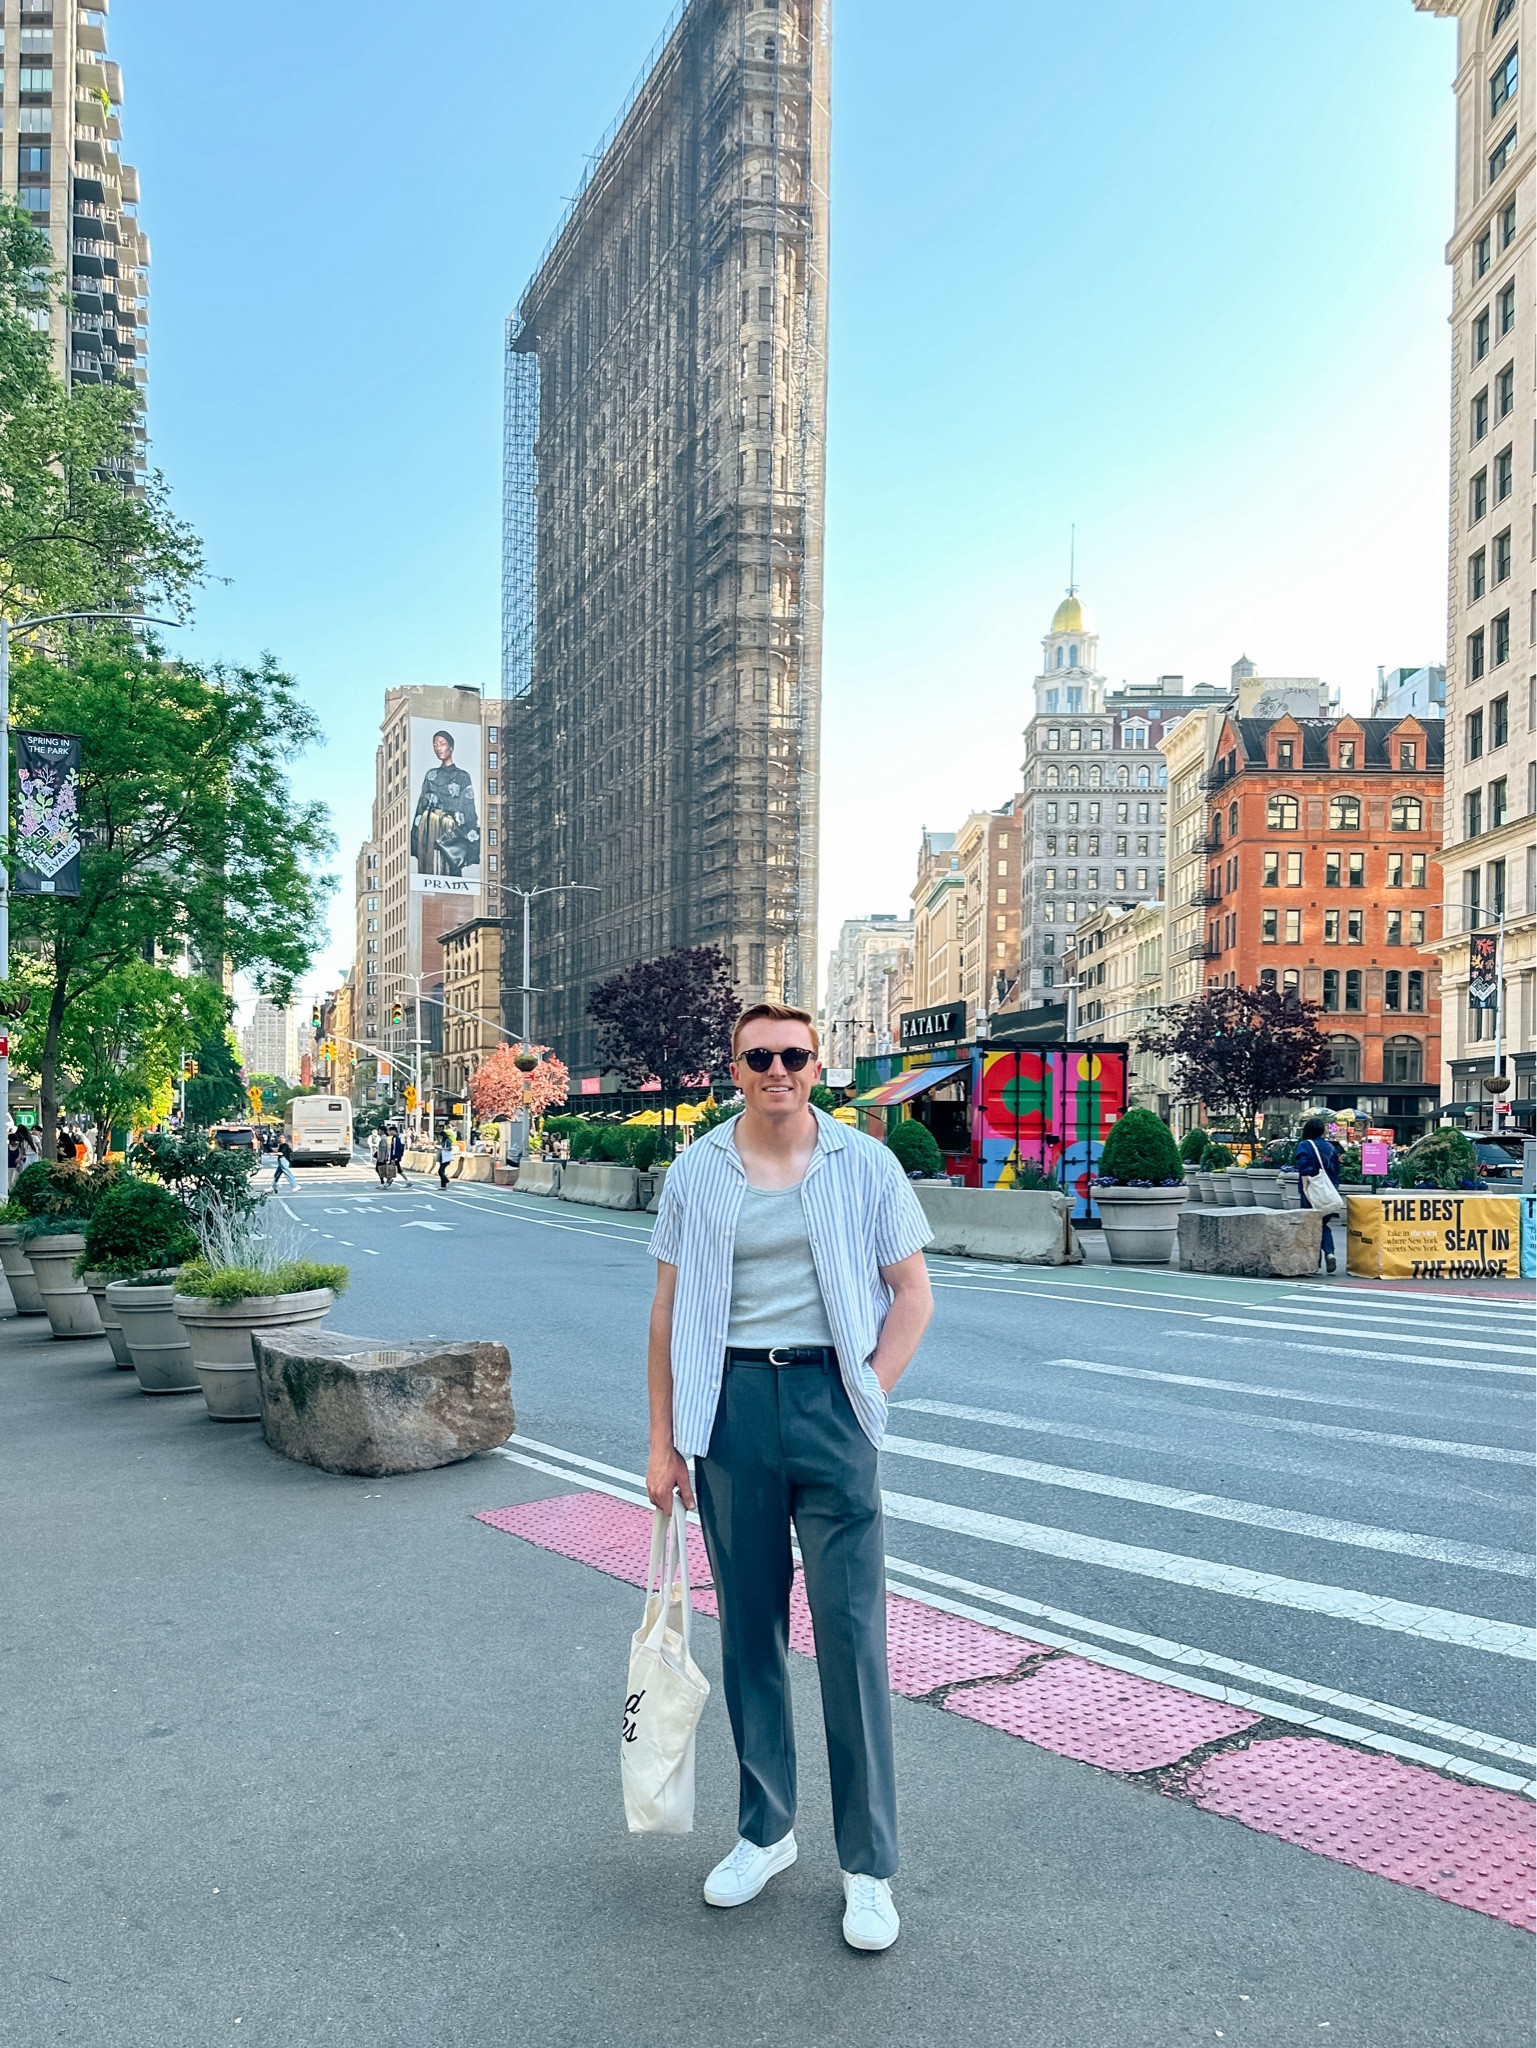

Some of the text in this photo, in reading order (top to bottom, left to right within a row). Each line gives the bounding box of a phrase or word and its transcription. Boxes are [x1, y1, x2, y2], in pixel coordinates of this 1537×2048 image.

[27, 736, 70, 747] SPRING IN
[29, 745, 69, 755] THE PARK
[424, 879, 469, 891] PRADA
[902, 1012, 951, 1038] EATALY
[17, 1114, 35, 1126] TD
[323, 1204, 437, 1214] ONLY
[1382, 1200, 1464, 1228] THE BEST
[1444, 1229, 1510, 1257] SEAT IN
[1411, 1259, 1508, 1279] THE HOUSE
